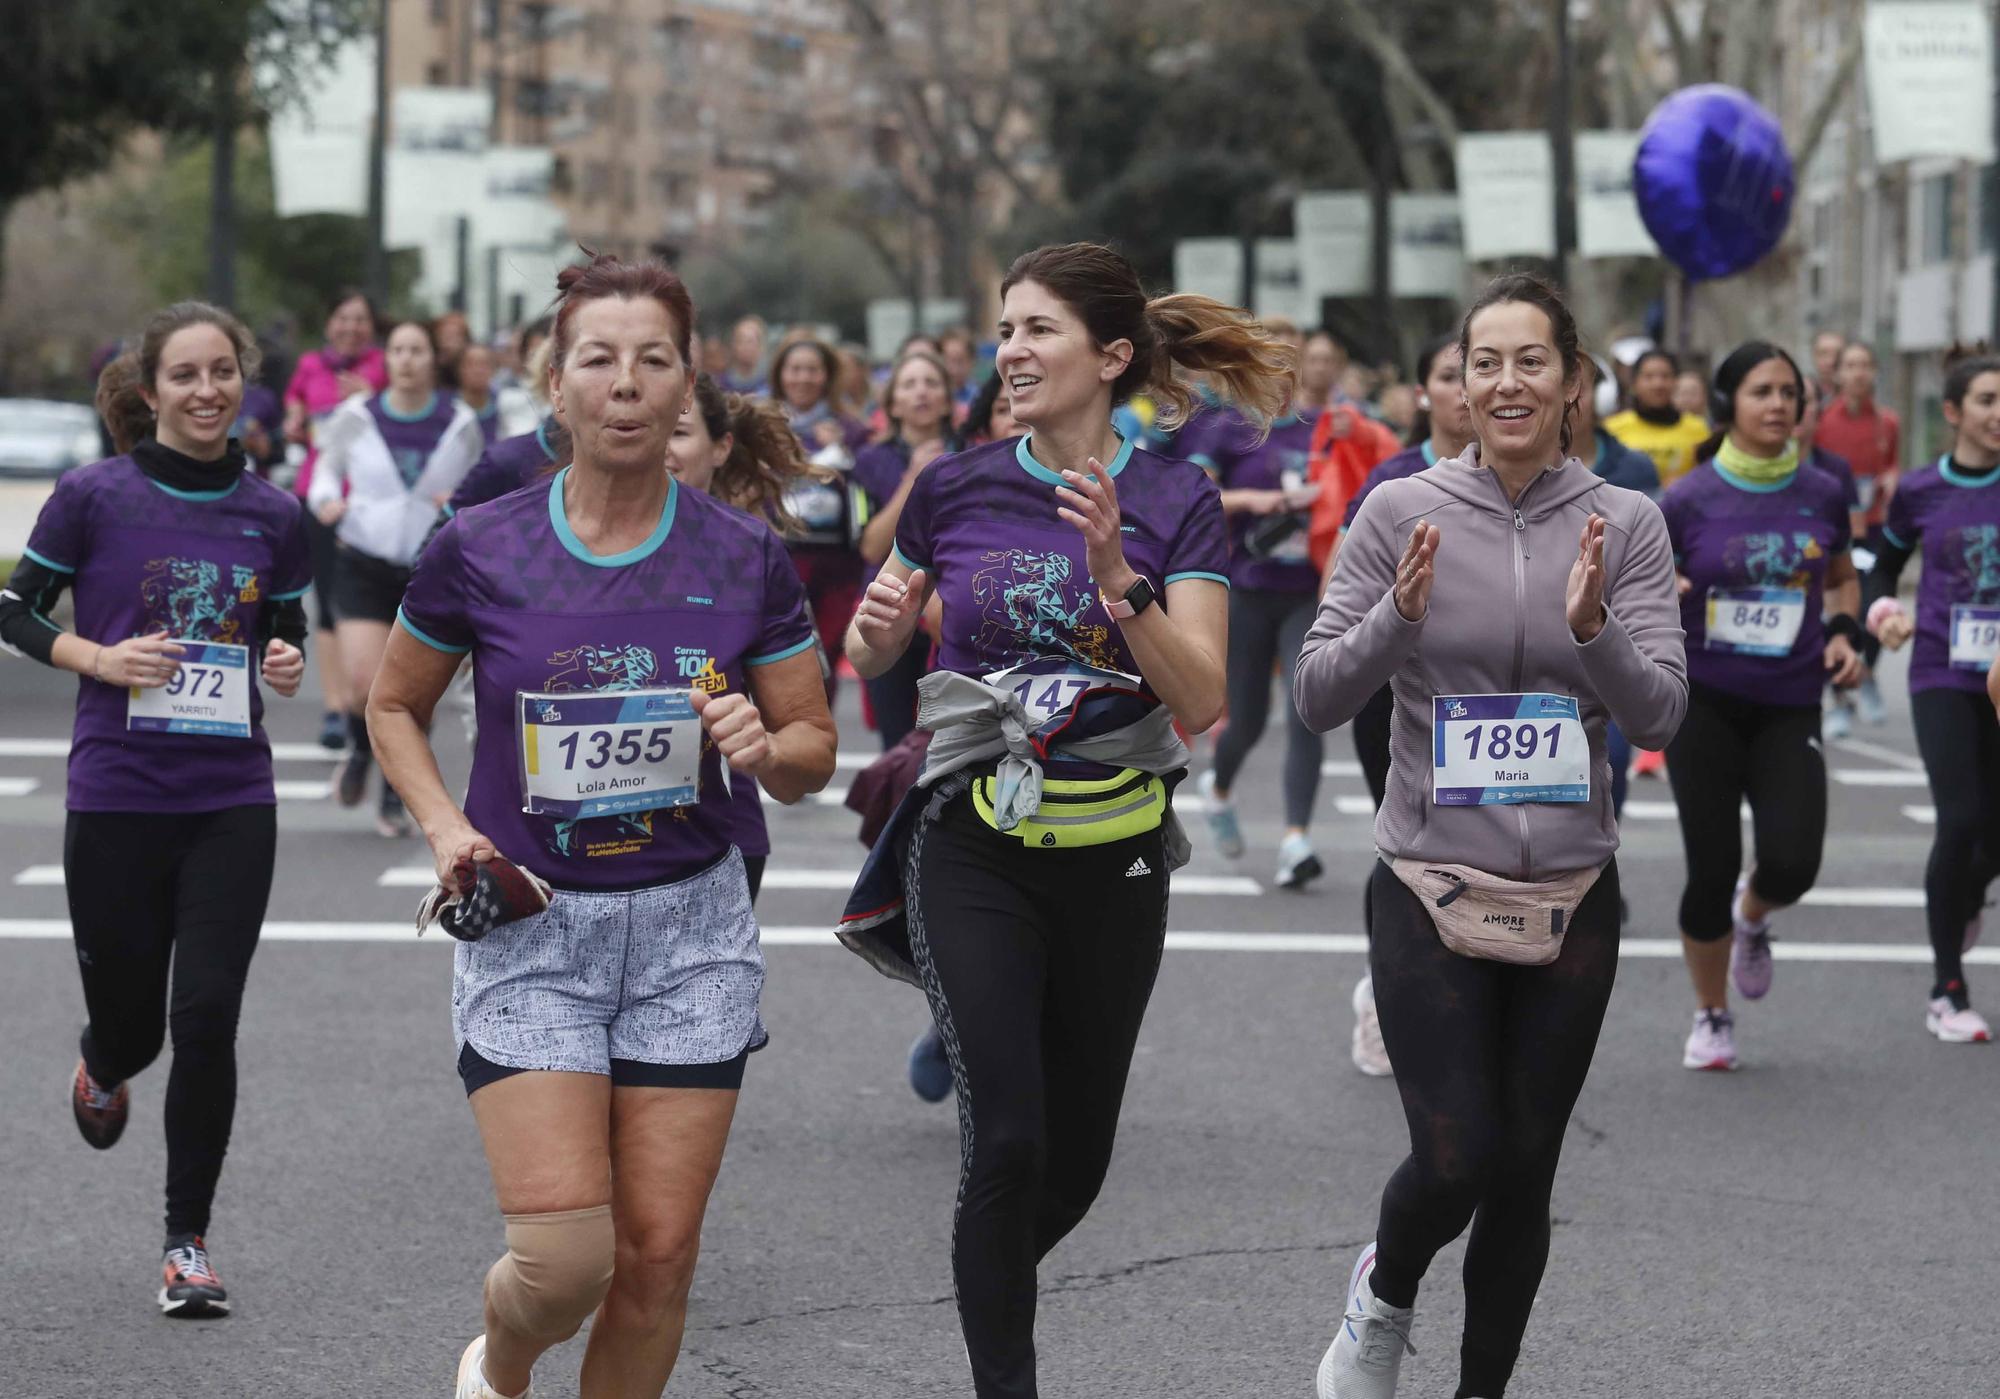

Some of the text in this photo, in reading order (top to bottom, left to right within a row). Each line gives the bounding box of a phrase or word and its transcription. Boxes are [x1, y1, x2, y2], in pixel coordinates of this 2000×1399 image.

[1732, 605, 1780, 628] 845
[1970, 626, 2000, 645] 19
[674, 646, 707, 656] Carrera
[675, 655, 716, 678] 10K
[165, 667, 225, 699] 972
[695, 675, 725, 691] FEM
[1013, 678, 1112, 714] 147
[171, 704, 217, 716] YARRITU
[557, 726, 673, 771] 1355
[1463, 722, 1562, 761] 1891
[576, 775, 647, 794] Lola Amor
[1494, 769, 1529, 782] Maria
[1125, 867, 1152, 878] adidas
[1483, 914, 1526, 926] AMORE
